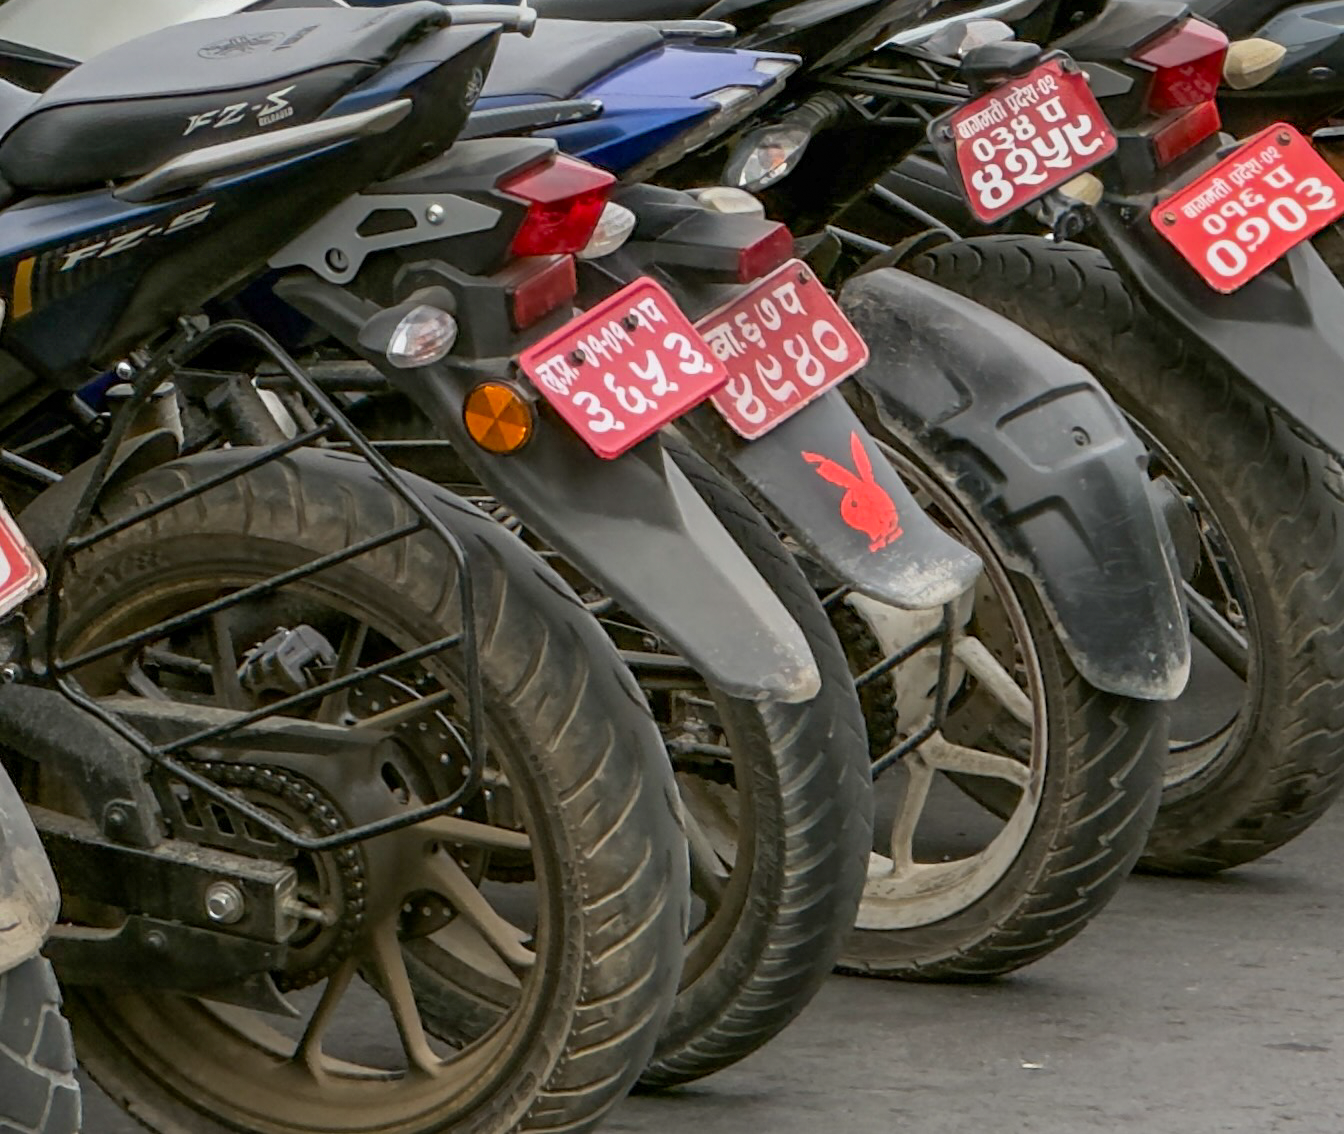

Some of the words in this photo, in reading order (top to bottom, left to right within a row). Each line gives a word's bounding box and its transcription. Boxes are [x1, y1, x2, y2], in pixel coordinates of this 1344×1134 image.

[956, 98, 1008, 139] बागमती
[972, 114, 1036, 162] ०३४
[1035, 96, 1067, 123] प
[1181, 177, 1233, 219] बागमती
[1202, 187, 1266, 235] ०१६
[1262, 164, 1295, 189] प
[60, 202, 216, 271] FZ-S
[572, 332, 714, 433] ३६५३
